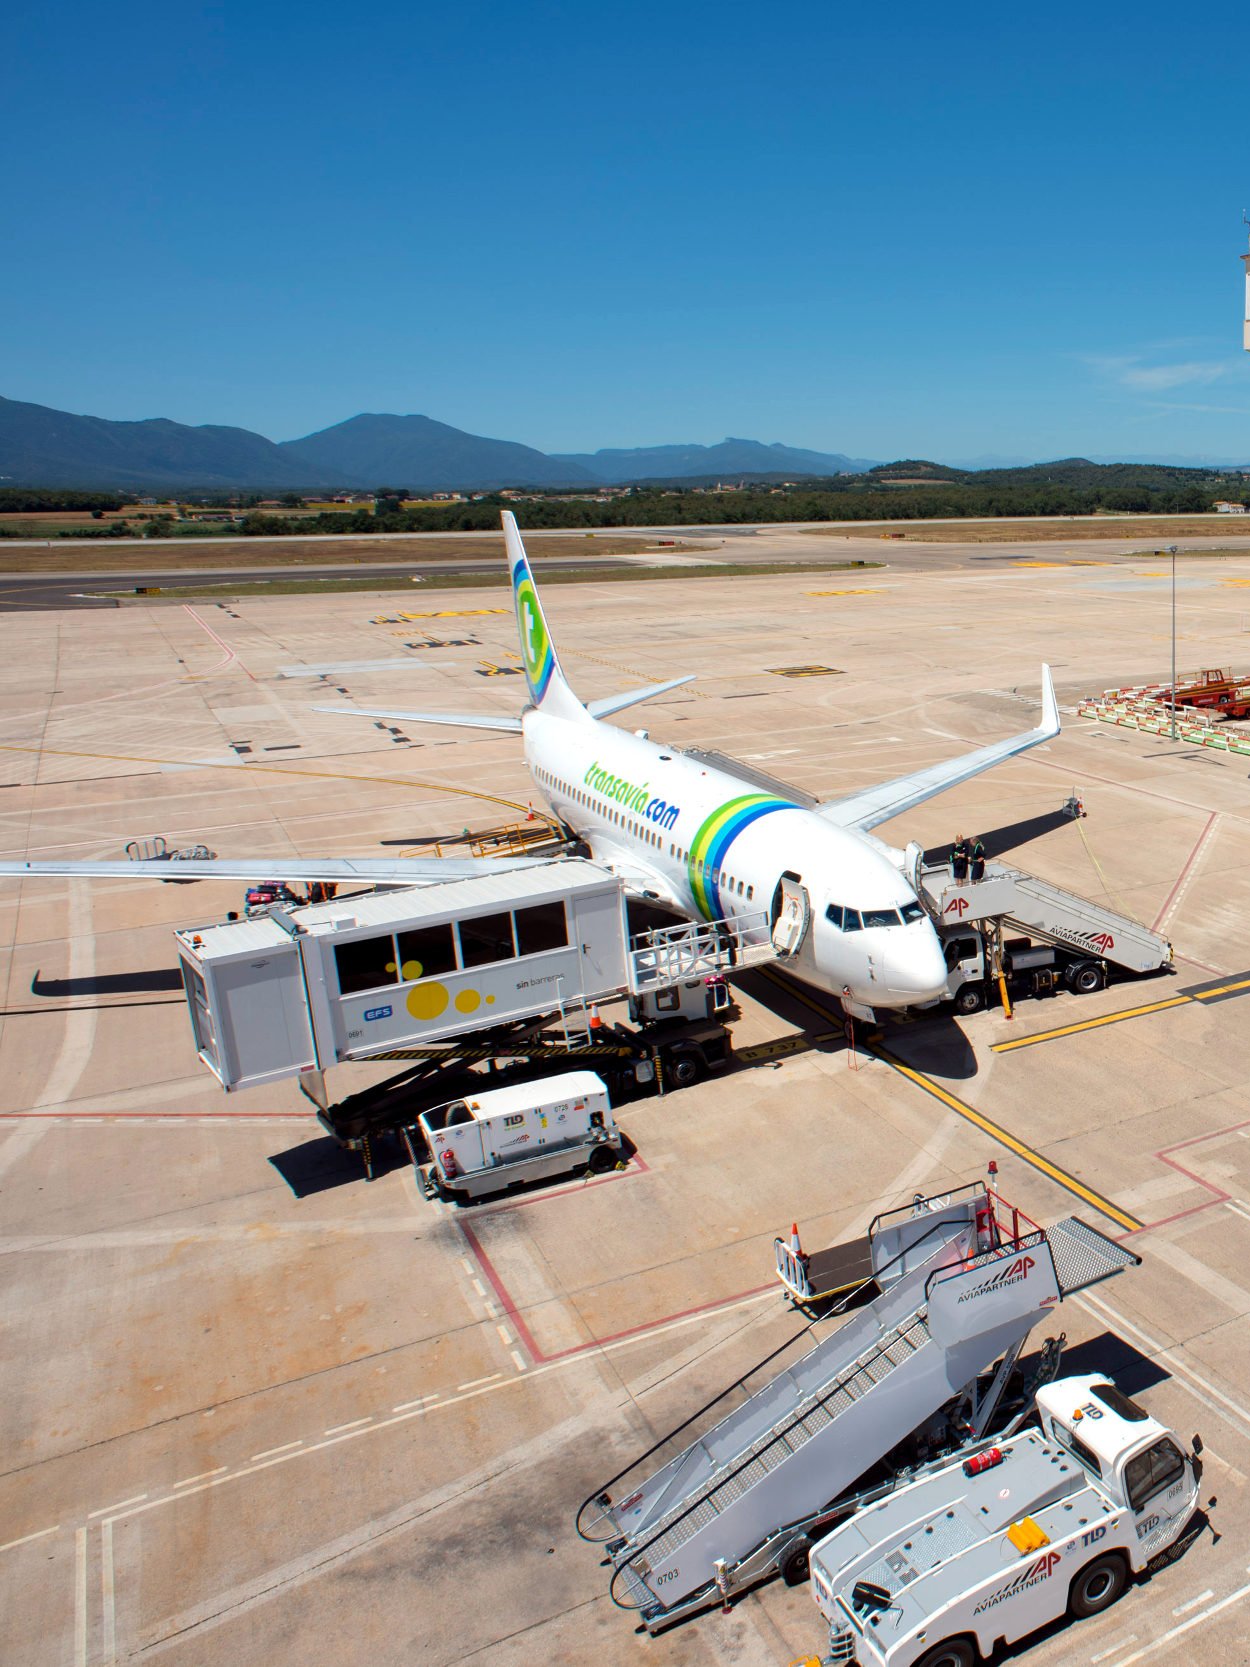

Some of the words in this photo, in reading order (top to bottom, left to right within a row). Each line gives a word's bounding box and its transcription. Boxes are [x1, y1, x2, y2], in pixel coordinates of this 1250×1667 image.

[523, 601, 537, 664] t
[583, 760, 681, 831] transavia.com
[943, 897, 970, 918] AP
[1049, 926, 1102, 954] AVIAPARTNER
[516, 980, 529, 990] sin
[367, 1007, 391, 1019] EFS
[503, 1114, 524, 1127] TLD
[957, 1274, 1023, 1304] AVIAPARTNER
[1007, 1256, 1036, 1279] AP
[1080, 1401, 1104, 1420] TLD
[1081, 1525, 1107, 1547] TLD
[657, 1568, 679, 1586] 0703
[973, 1572, 1048, 1617] AVIAPARTNER
[1030, 1551, 1062, 1577] AP
